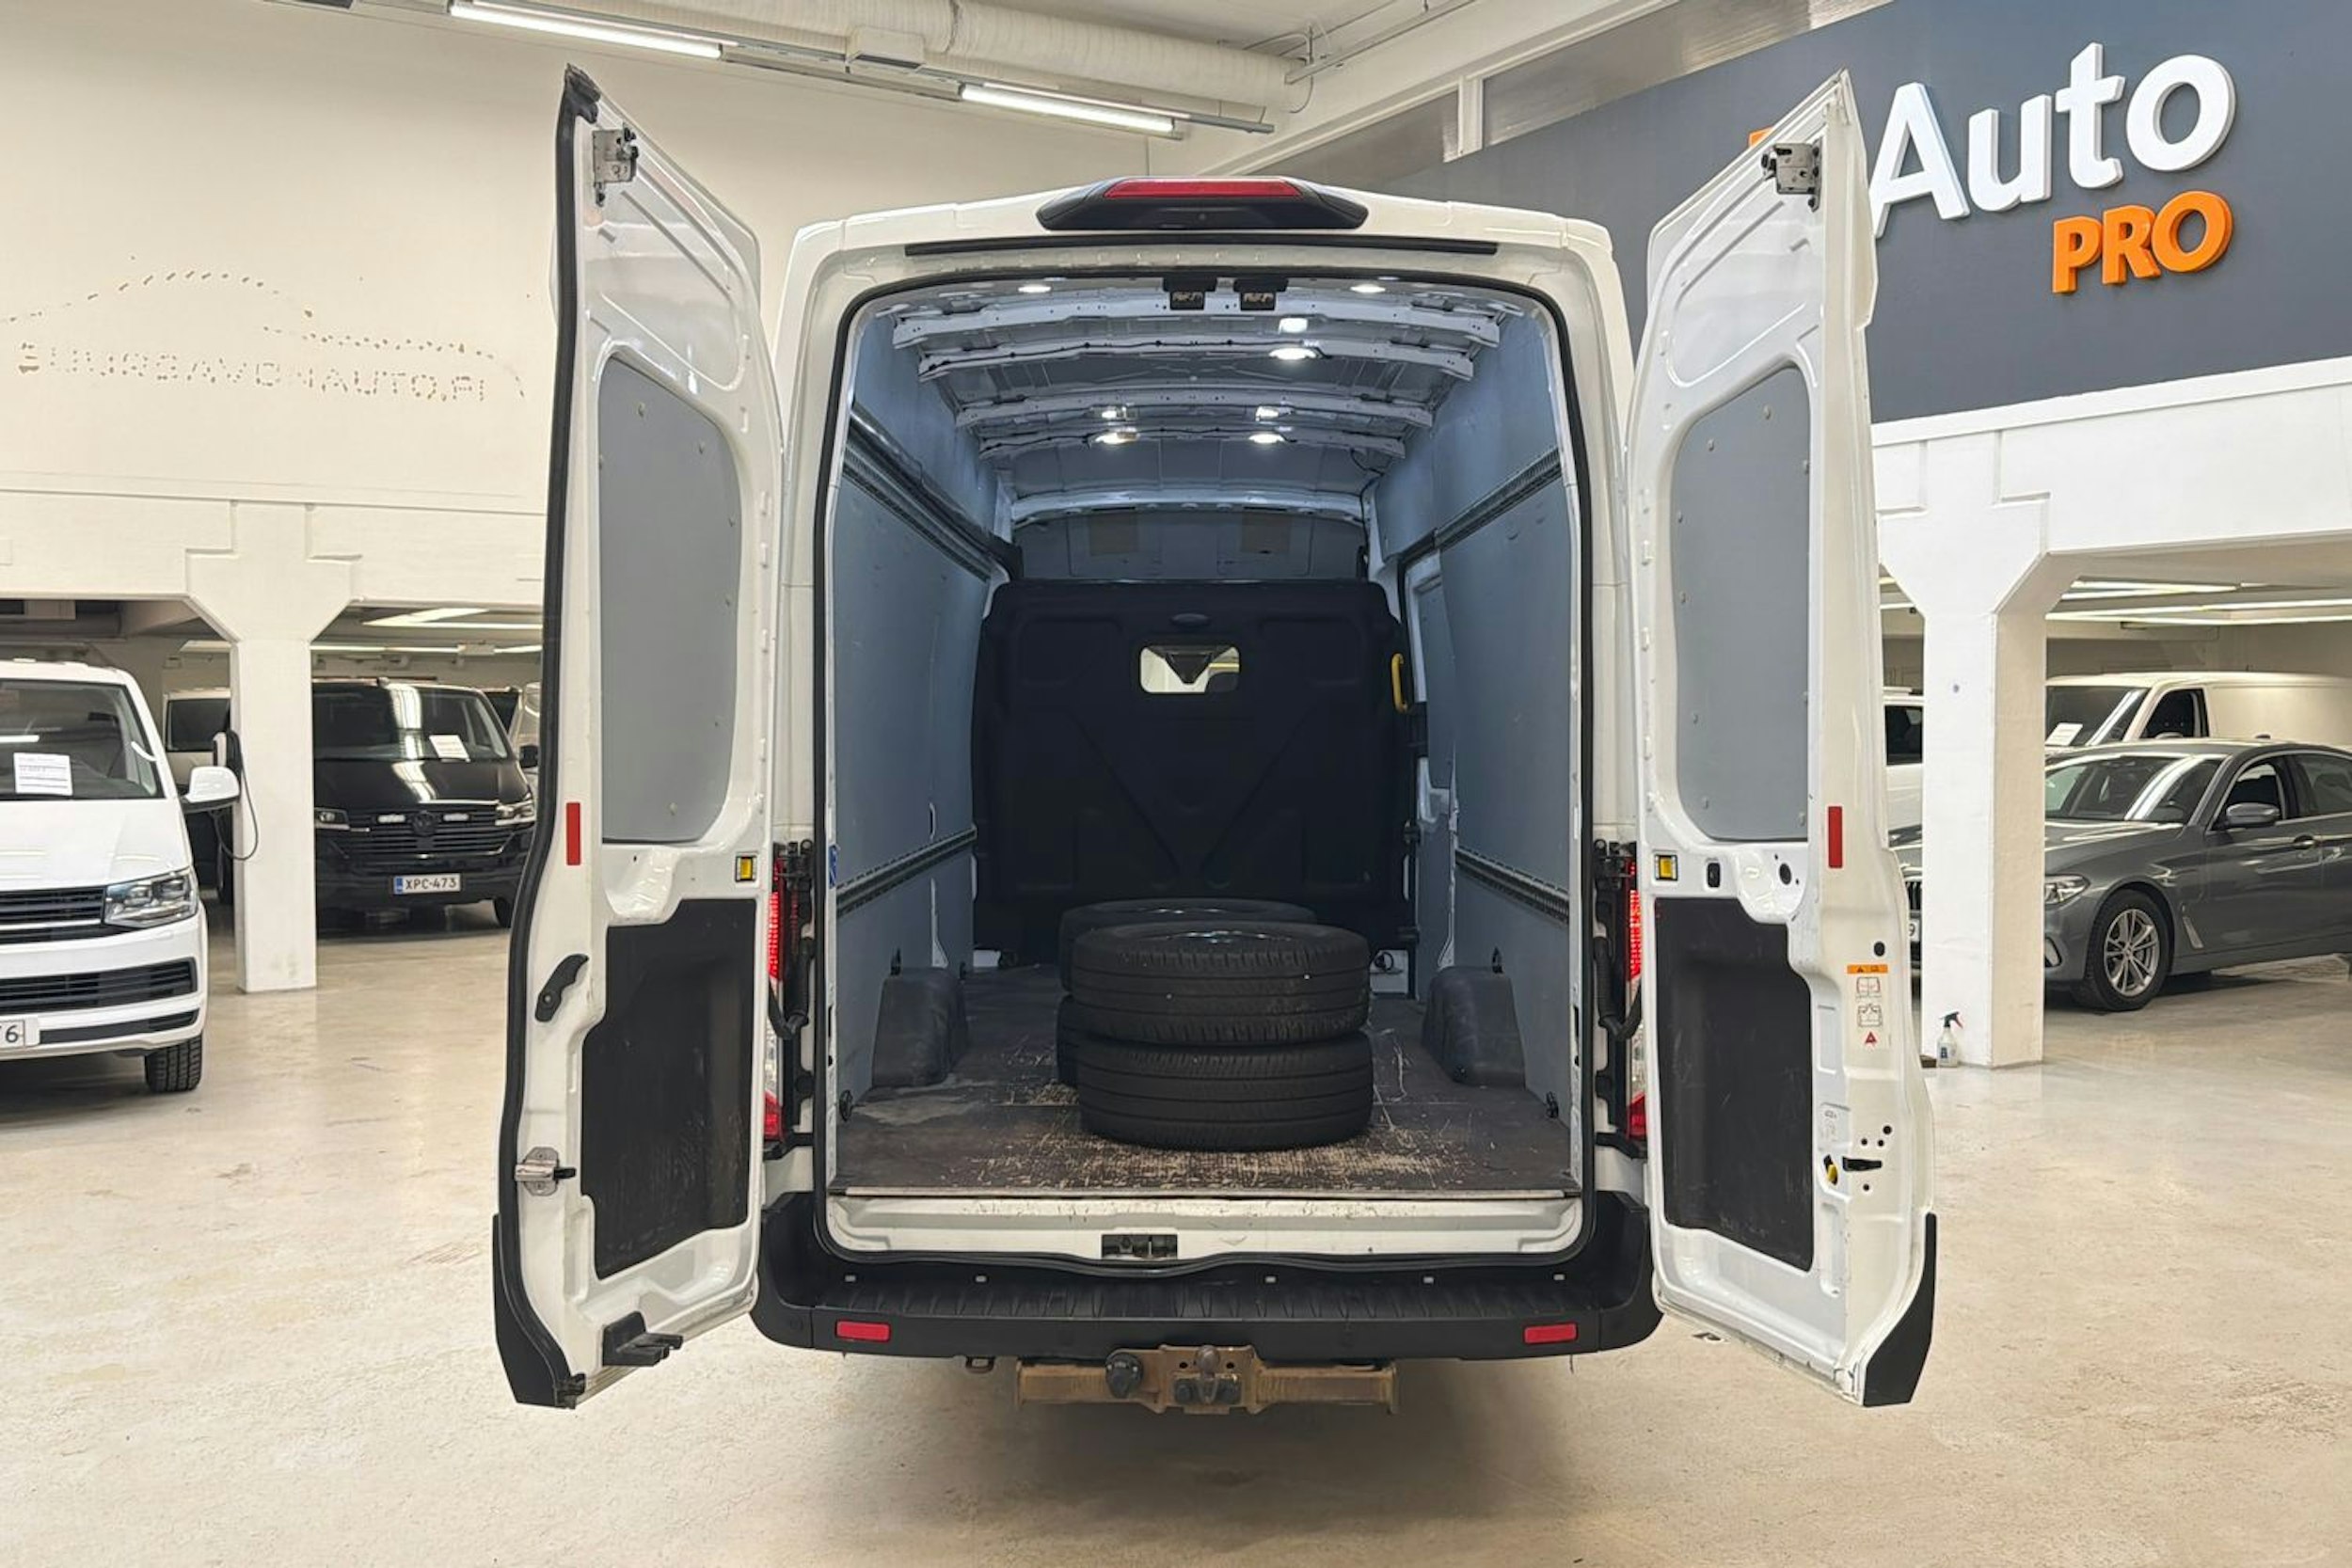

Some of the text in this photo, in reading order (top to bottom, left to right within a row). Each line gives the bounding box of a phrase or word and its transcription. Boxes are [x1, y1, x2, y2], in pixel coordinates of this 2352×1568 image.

[1868, 41, 2236, 239] Auto
[2052, 190, 2233, 293] PRO
[405, 878, 457, 890] XPC-473
[0, 1024, 19, 1043] 6
